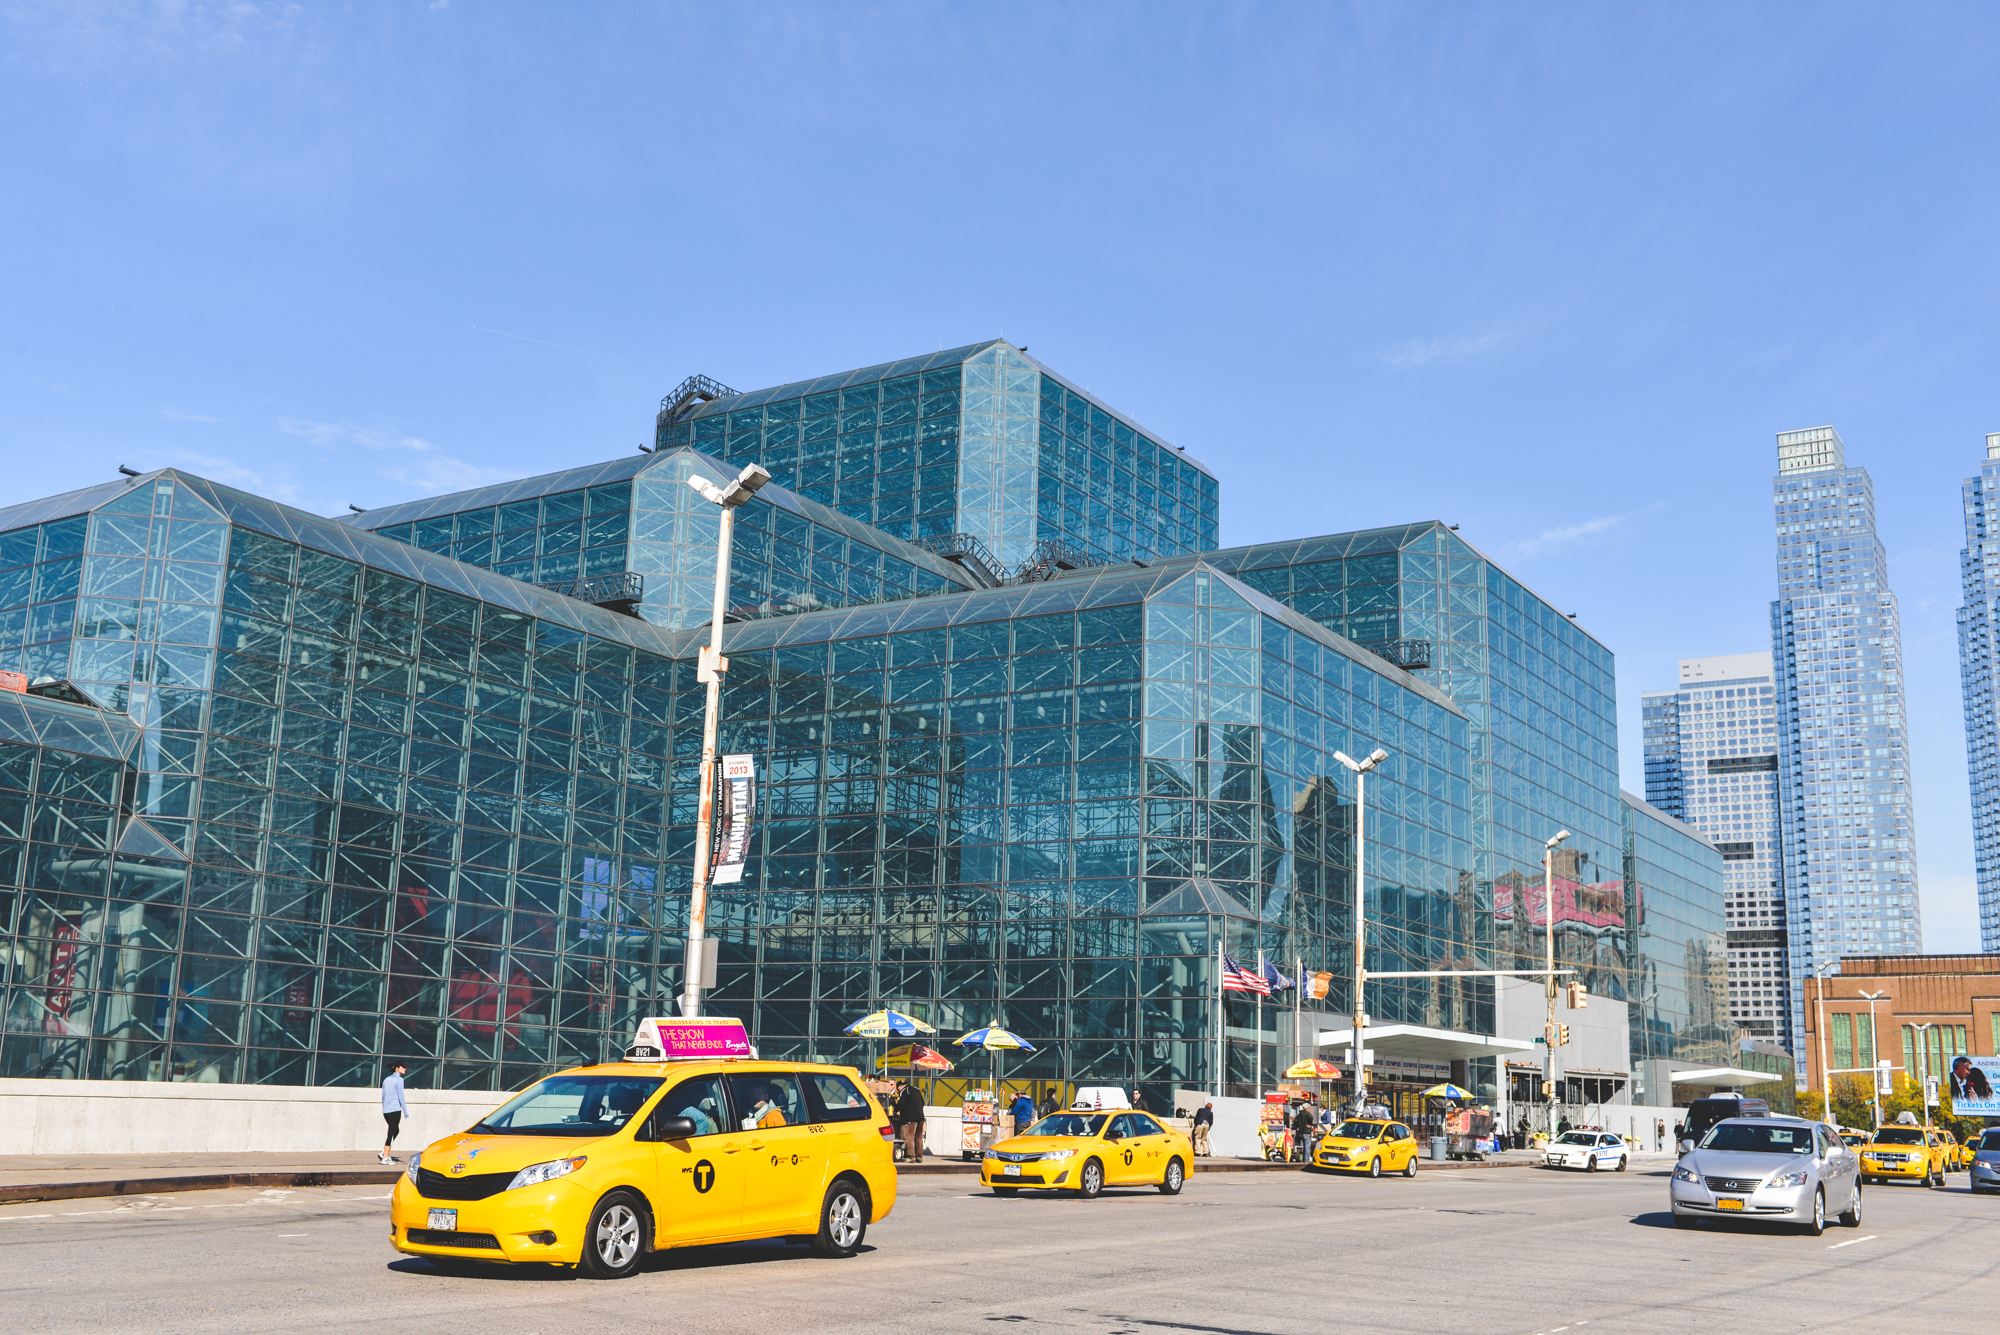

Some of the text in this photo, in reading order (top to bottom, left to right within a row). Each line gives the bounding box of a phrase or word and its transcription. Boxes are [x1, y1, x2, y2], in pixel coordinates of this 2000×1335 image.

[729, 766, 748, 775] 2013
[727, 781, 747, 861] MANHATTAN
[289, 978, 298, 1017] JVIT
[660, 1029, 678, 1040] THE
[678, 1029, 704, 1040] SHOW
[671, 1041, 687, 1049] THAT
[687, 1040, 707, 1049] NEVER
[707, 1040, 724, 1049] ENDS.
[635, 1047, 650, 1056] 8V21
[808, 1125, 826, 1134] 8V21
[698, 1165, 710, 1190] T
